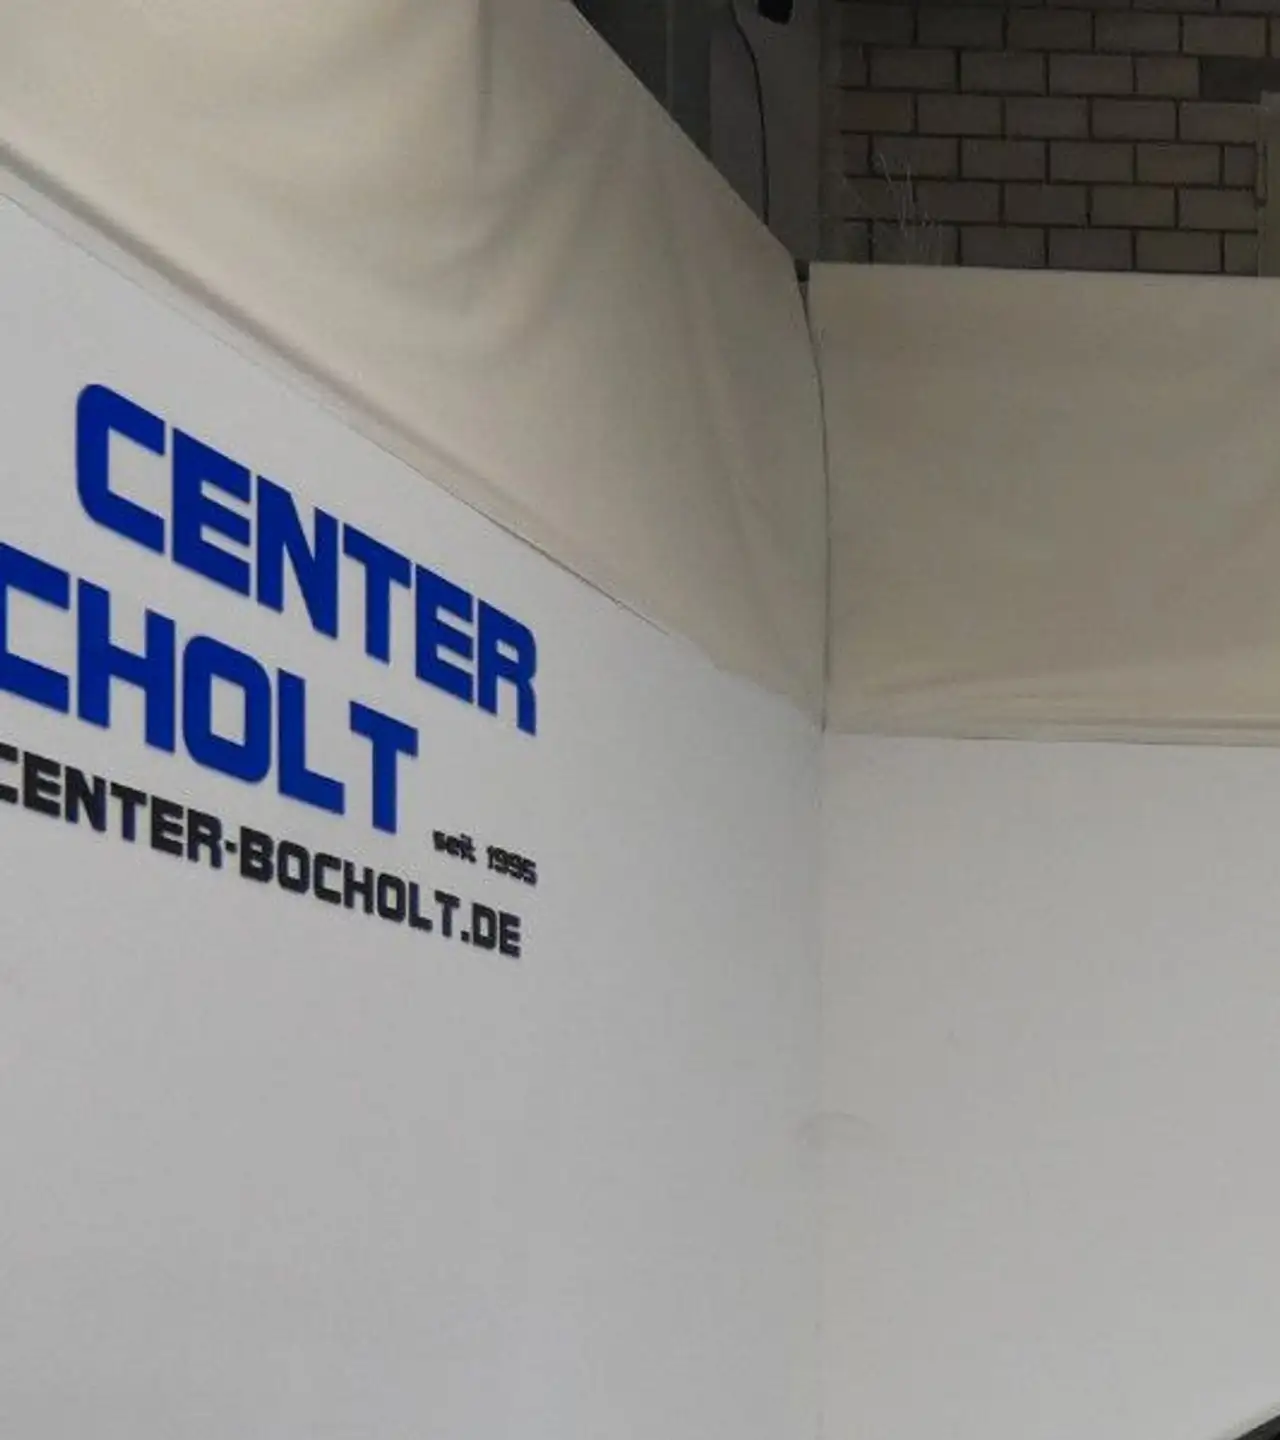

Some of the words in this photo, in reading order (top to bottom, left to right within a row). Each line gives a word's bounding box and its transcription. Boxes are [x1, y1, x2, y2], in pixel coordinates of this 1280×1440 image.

[76, 384, 537, 736] CENTER
[433, 830, 477, 863] seit
[486, 845, 538, 886] 1995
